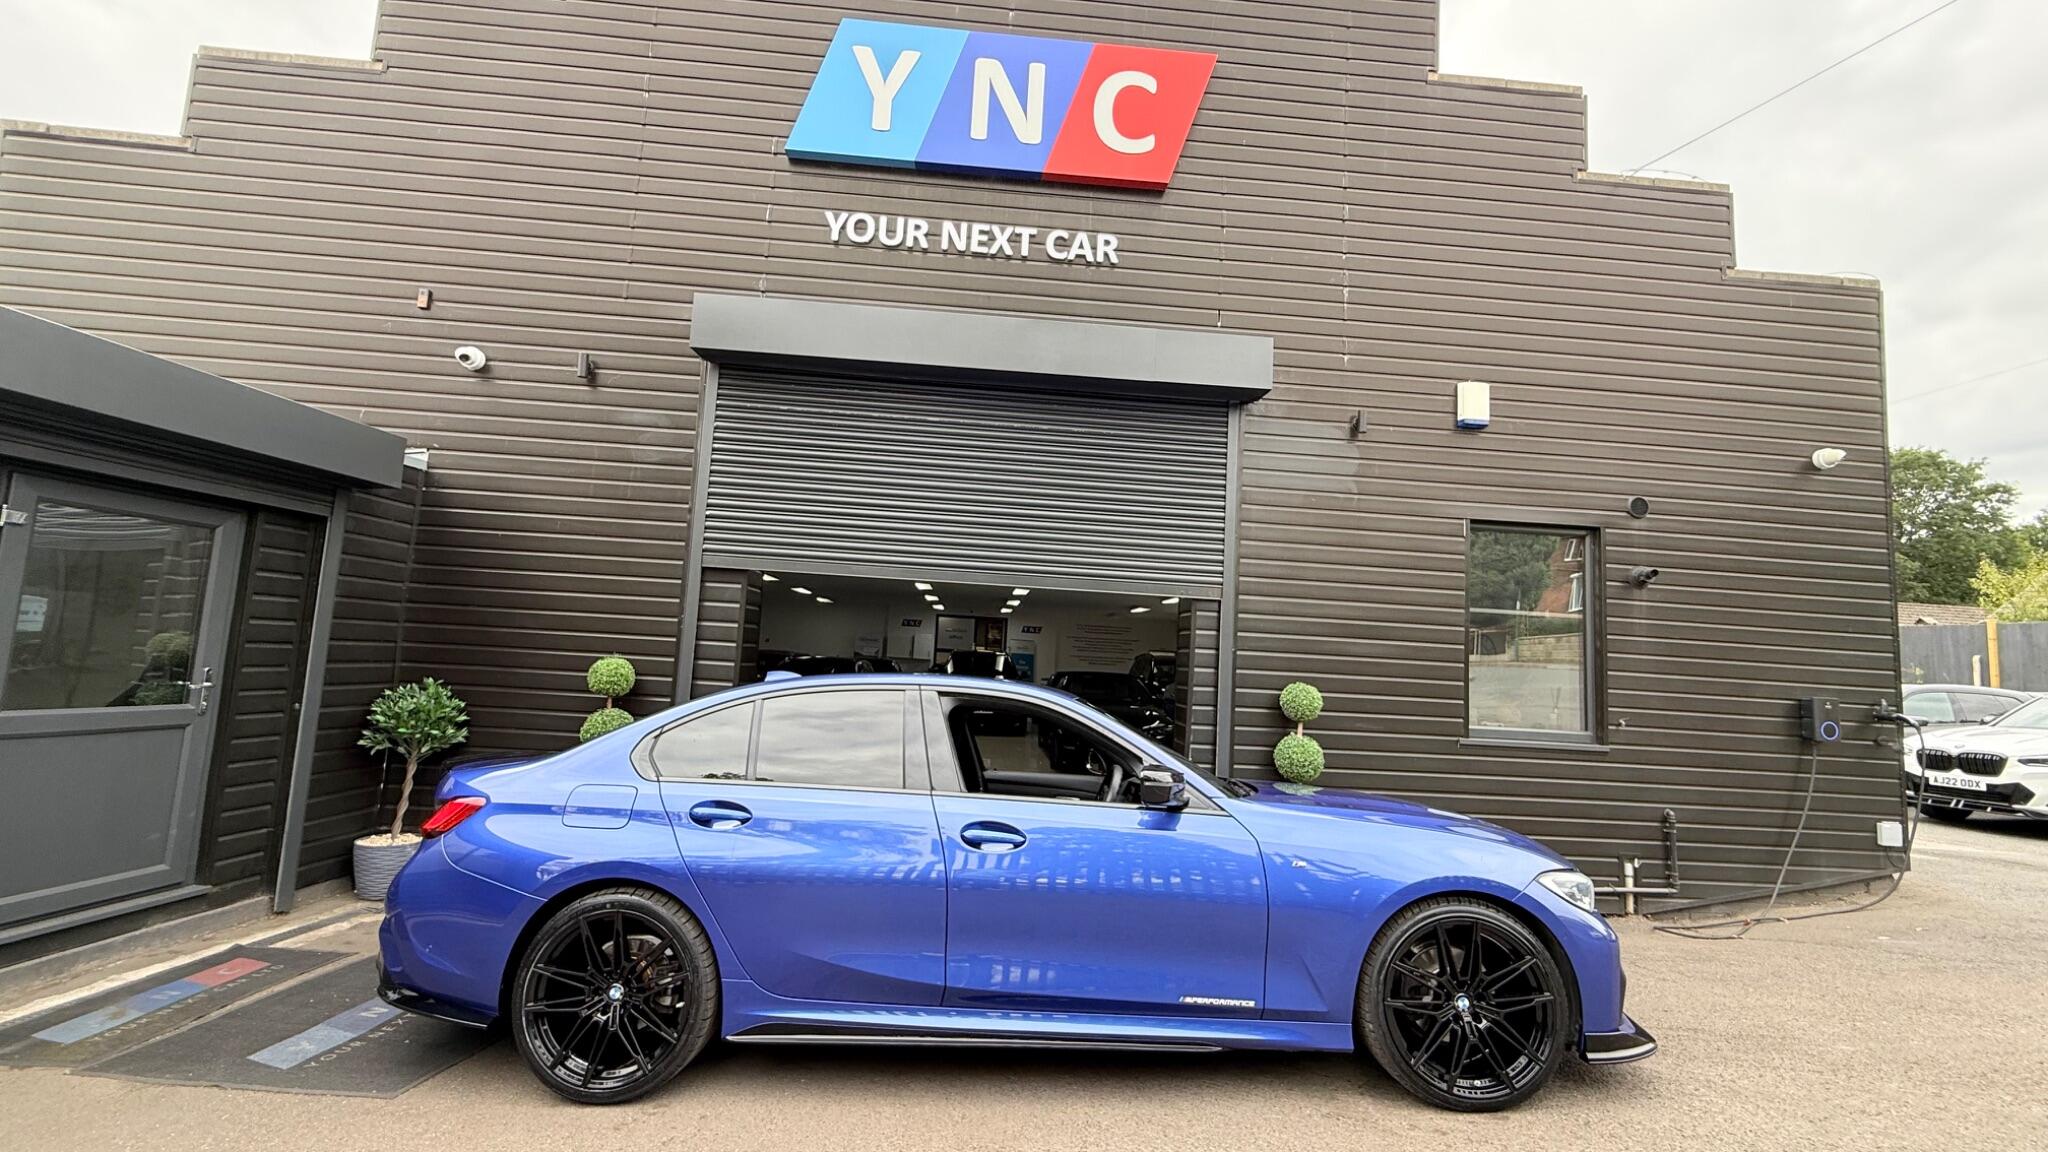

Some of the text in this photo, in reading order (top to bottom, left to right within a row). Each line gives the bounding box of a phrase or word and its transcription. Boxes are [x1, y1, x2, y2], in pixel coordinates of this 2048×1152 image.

[852, 45, 1158, 154] YNC
[824, 210, 1119, 265] YOUR NEXT CAR
[1933, 775, 1958, 786] AJ22
